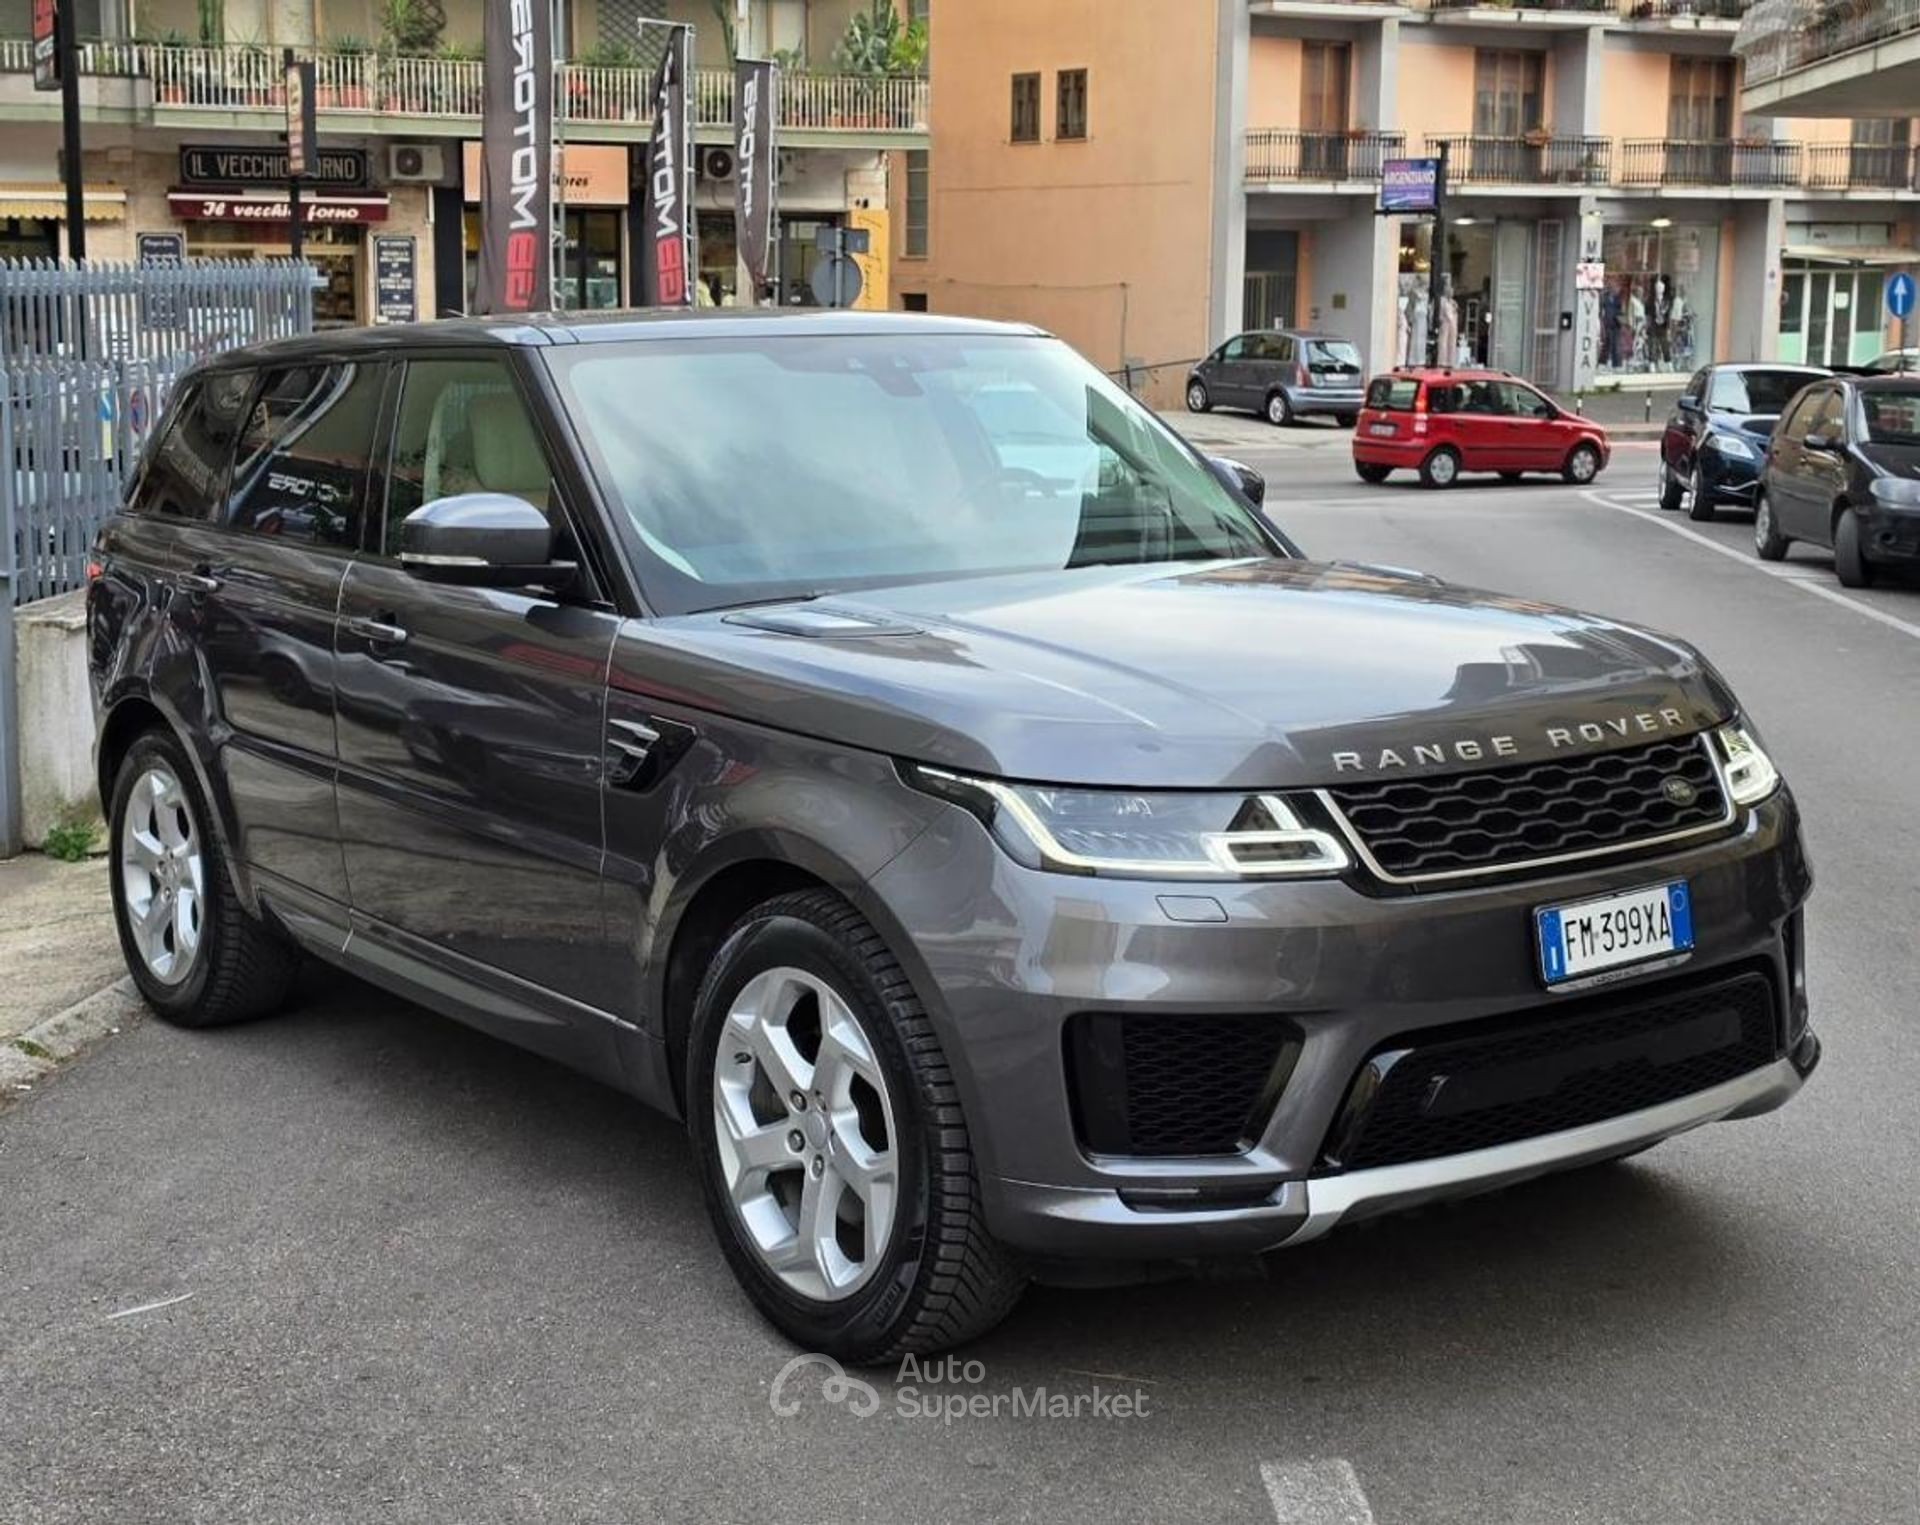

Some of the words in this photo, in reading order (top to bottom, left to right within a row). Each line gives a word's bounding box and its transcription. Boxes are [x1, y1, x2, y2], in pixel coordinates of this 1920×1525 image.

[191, 154, 207, 176] IL
[315, 156, 357, 180] ORNO
[202, 201, 226, 217] Il
[234, 202, 292, 218] vecchi
[306, 206, 359, 221] forno
[1333, 735, 1518, 773] RANGE
[1547, 707, 1684, 748] ROVER
